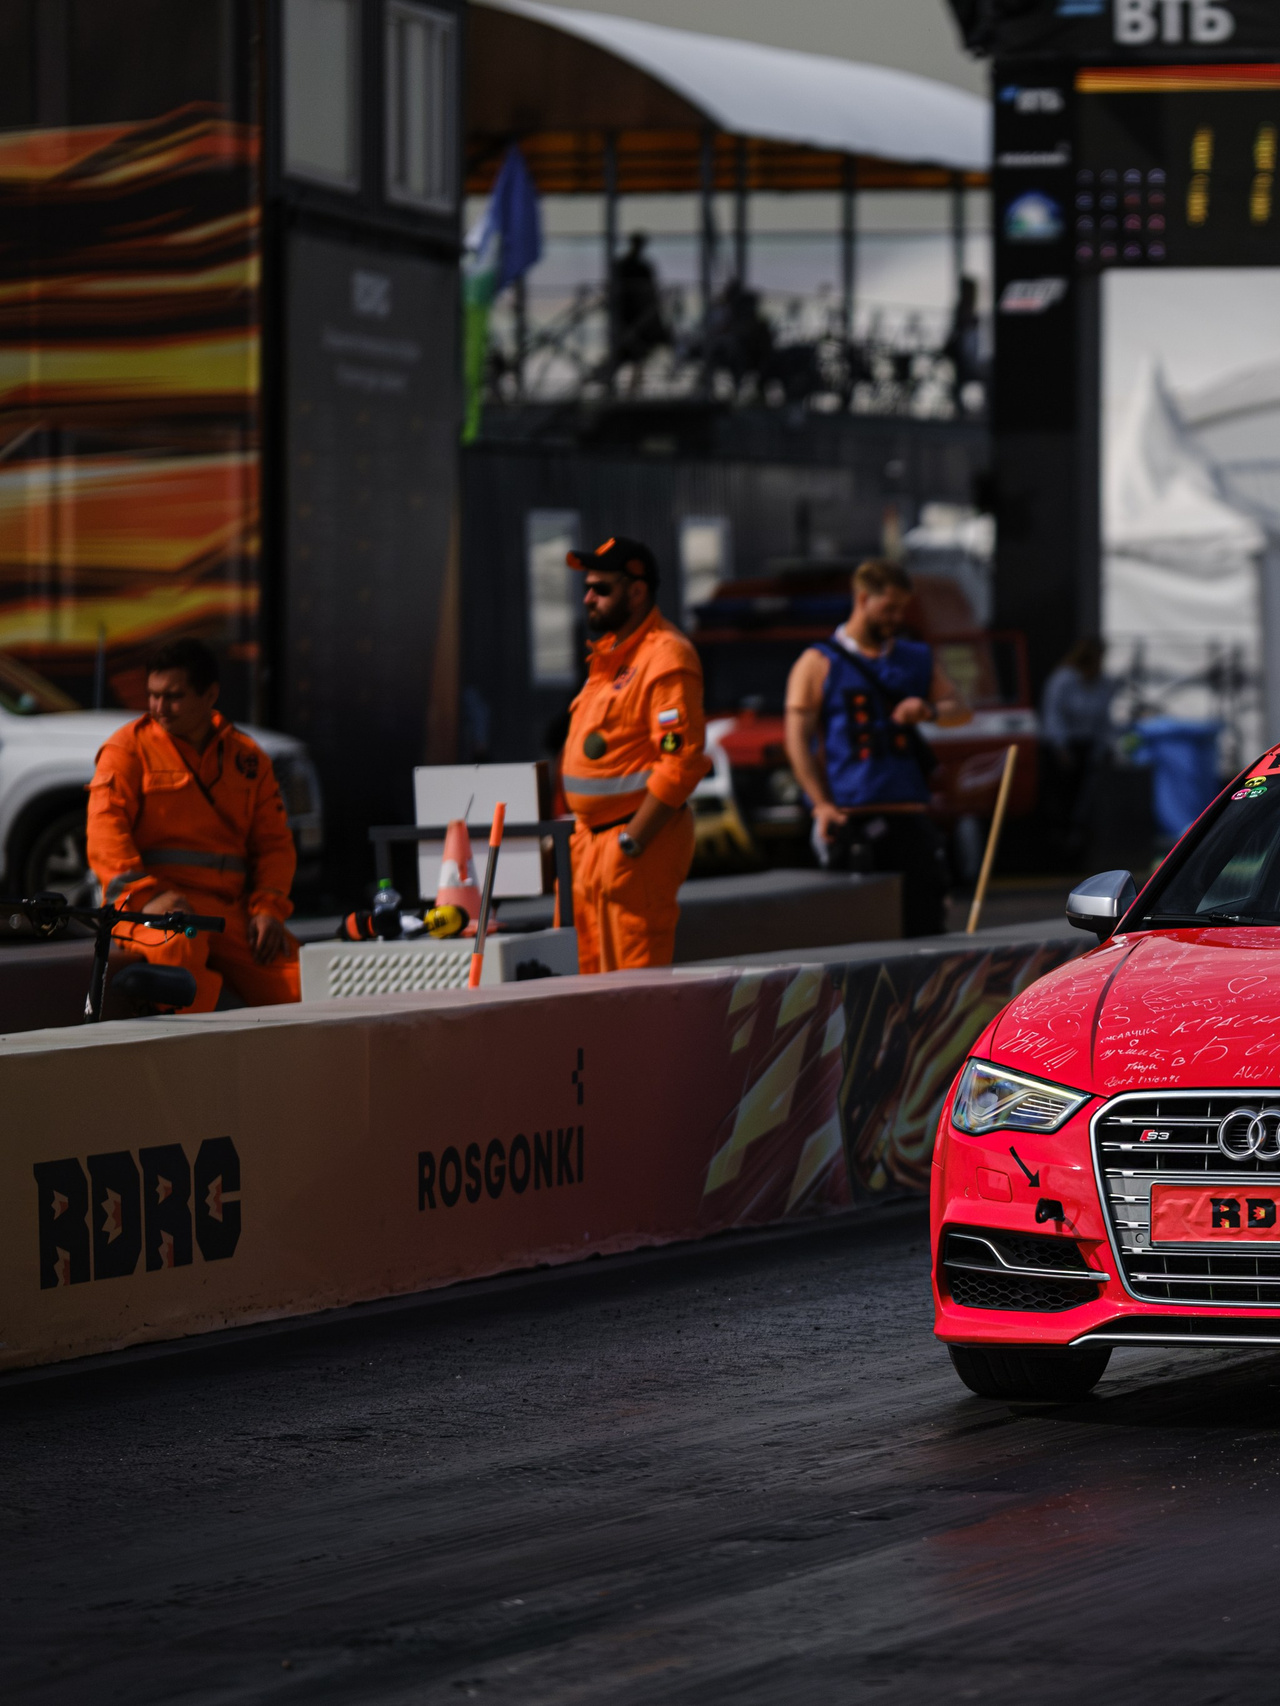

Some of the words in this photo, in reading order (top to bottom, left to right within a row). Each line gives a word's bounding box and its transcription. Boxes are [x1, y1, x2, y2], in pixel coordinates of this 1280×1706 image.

[418, 1126, 586, 1213] ROSGONKI
[1147, 1130, 1170, 1142] S3
[33, 1135, 242, 1291] RDRC
